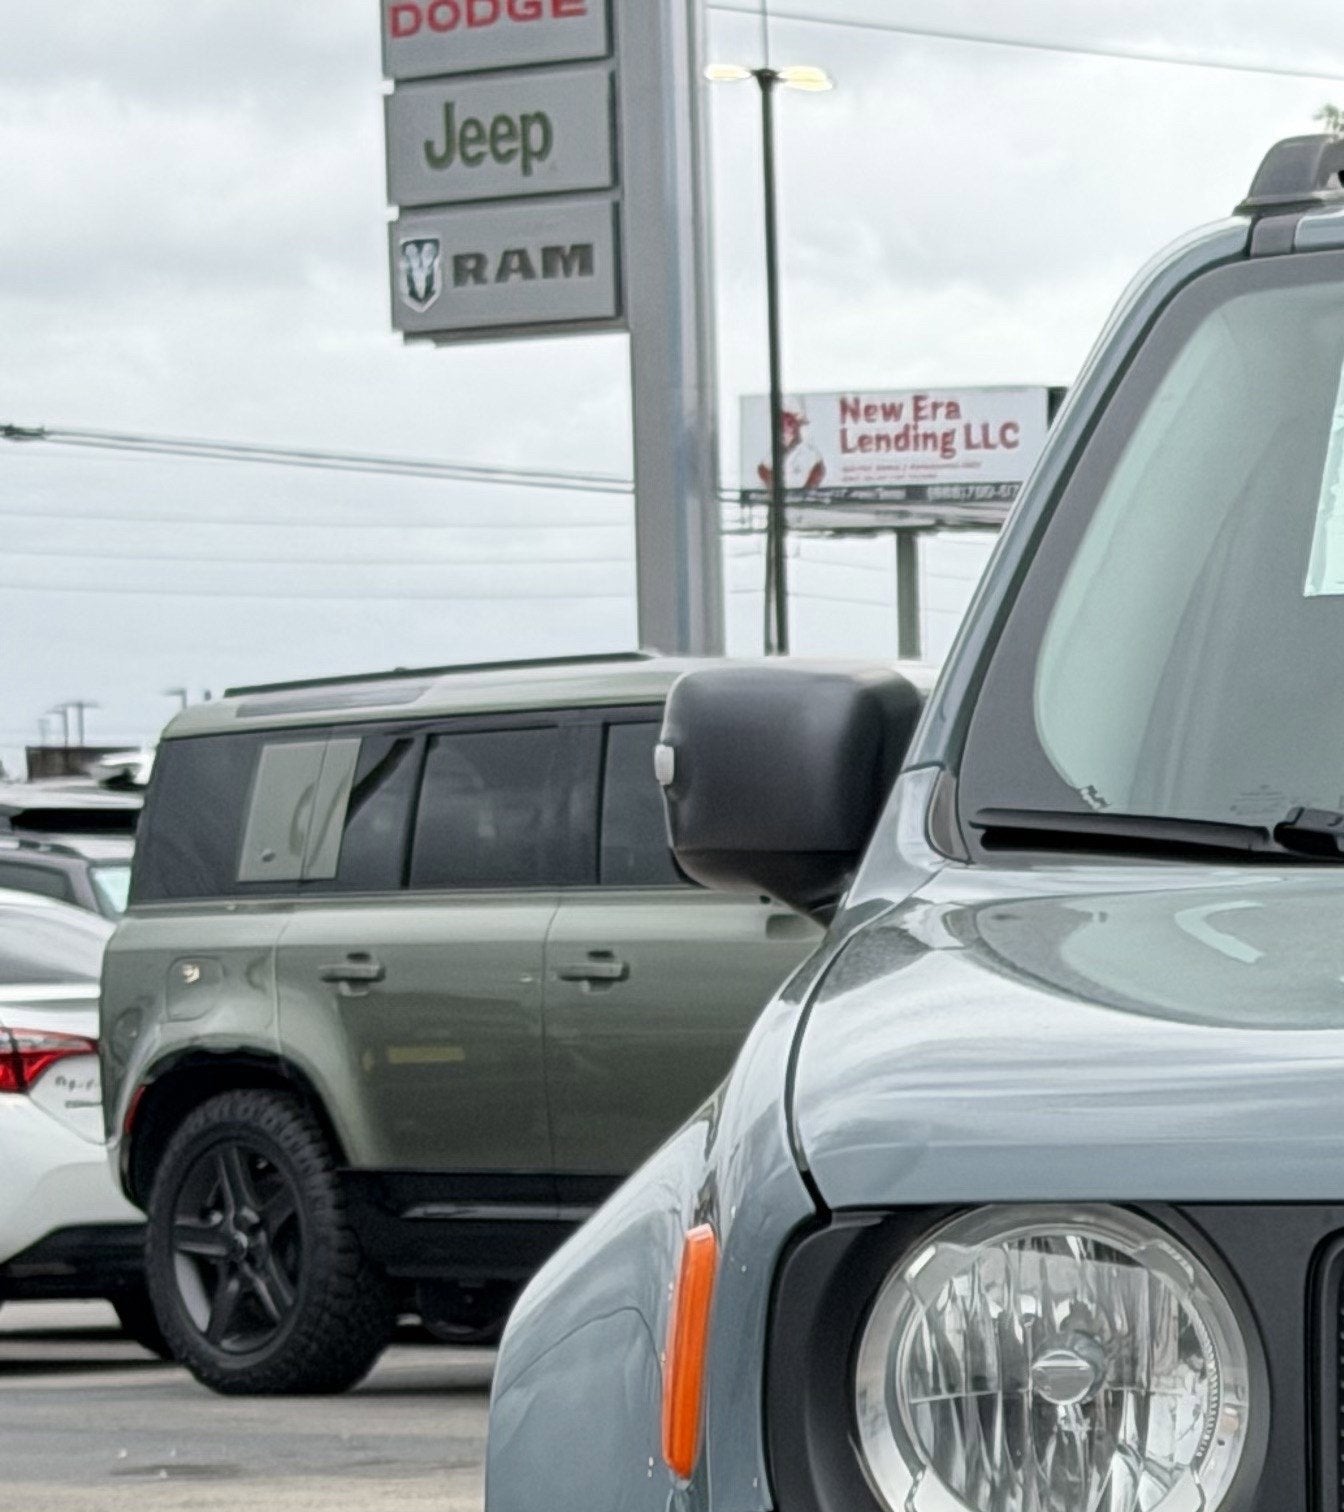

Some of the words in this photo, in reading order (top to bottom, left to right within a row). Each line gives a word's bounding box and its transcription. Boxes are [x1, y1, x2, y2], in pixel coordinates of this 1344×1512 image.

[389, 0, 588, 39] DODGE
[423, 101, 554, 177] Jeep
[452, 243, 595, 287] RAM
[839, 395, 904, 424] New
[912, 394, 962, 422] Era
[839, 424, 957, 459] Lending
[963, 421, 1021, 451] LLC
